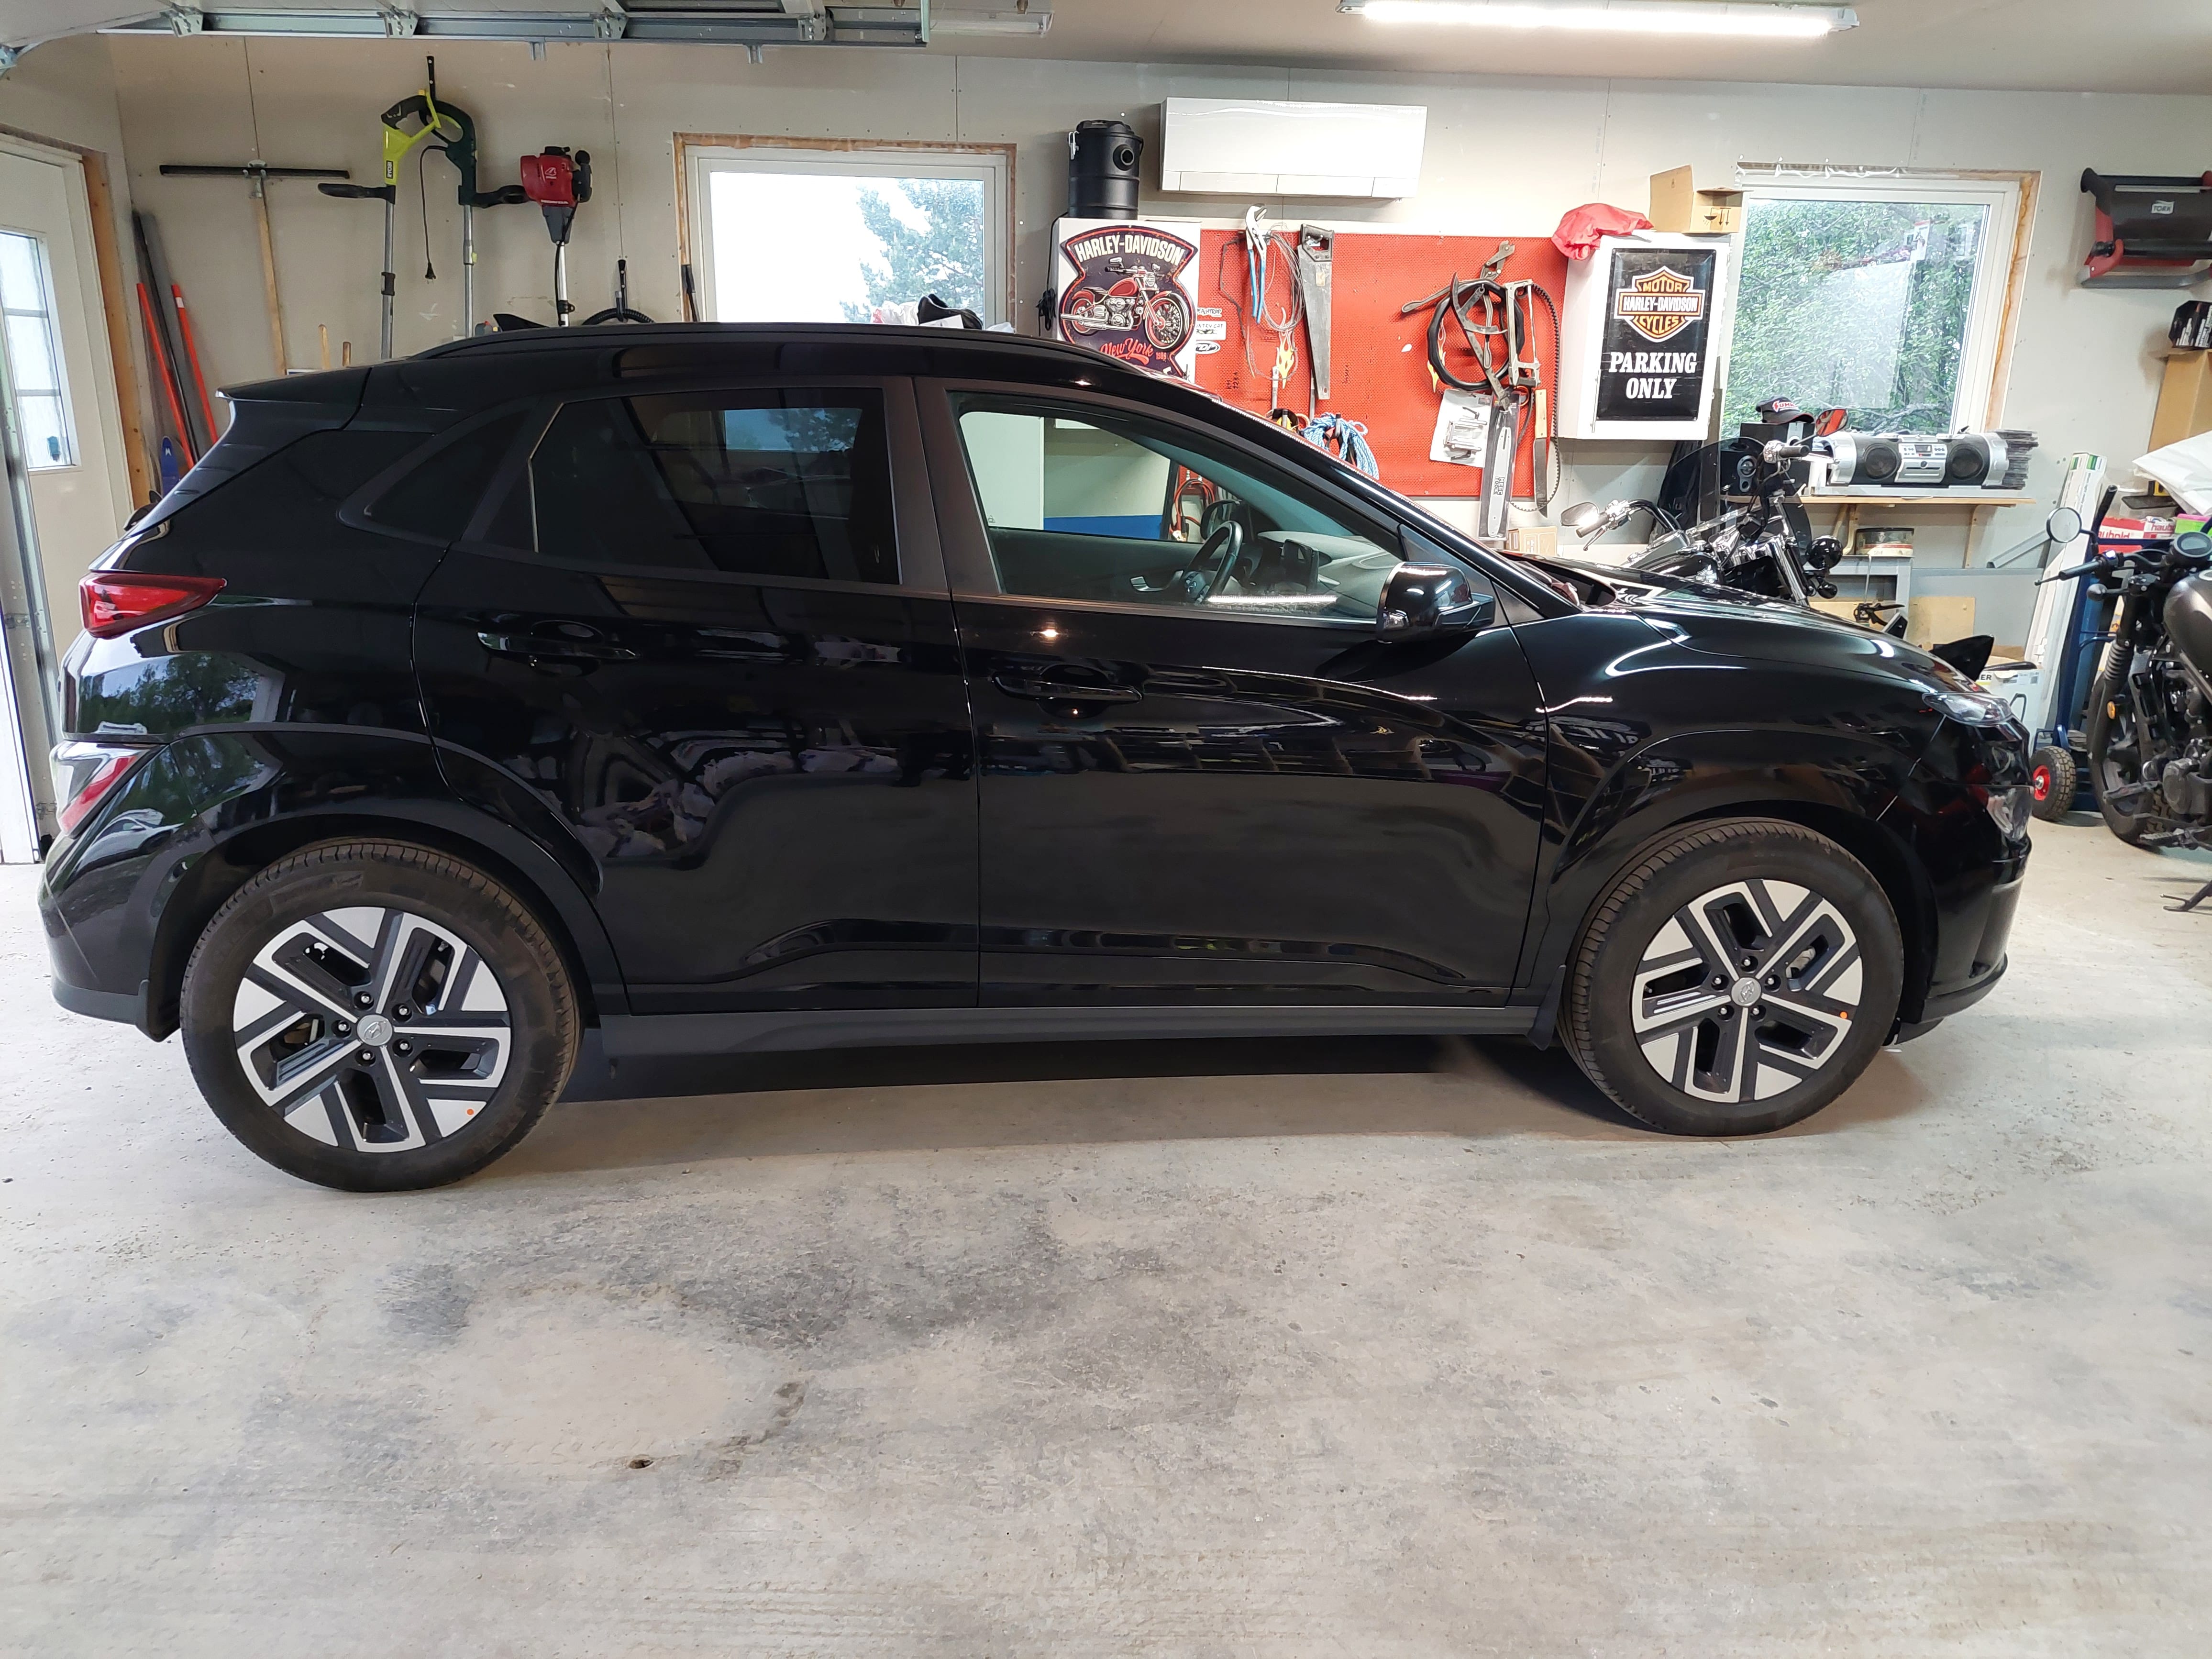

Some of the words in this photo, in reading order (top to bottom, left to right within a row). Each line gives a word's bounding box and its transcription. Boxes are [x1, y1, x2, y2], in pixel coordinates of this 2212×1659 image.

[1074, 234, 1185, 265] HARLEY-DAVIDSON
[1642, 278, 1683, 292] MOTOR
[1623, 296, 1699, 312] HARLEY-DAVIDSON
[1639, 315, 1680, 333] CYCLES
[1100, 342, 1125, 357] New
[1125, 338, 1154, 360] York
[1608, 352, 1697, 374] PARKING
[1626, 377, 1678, 399] ONLY
